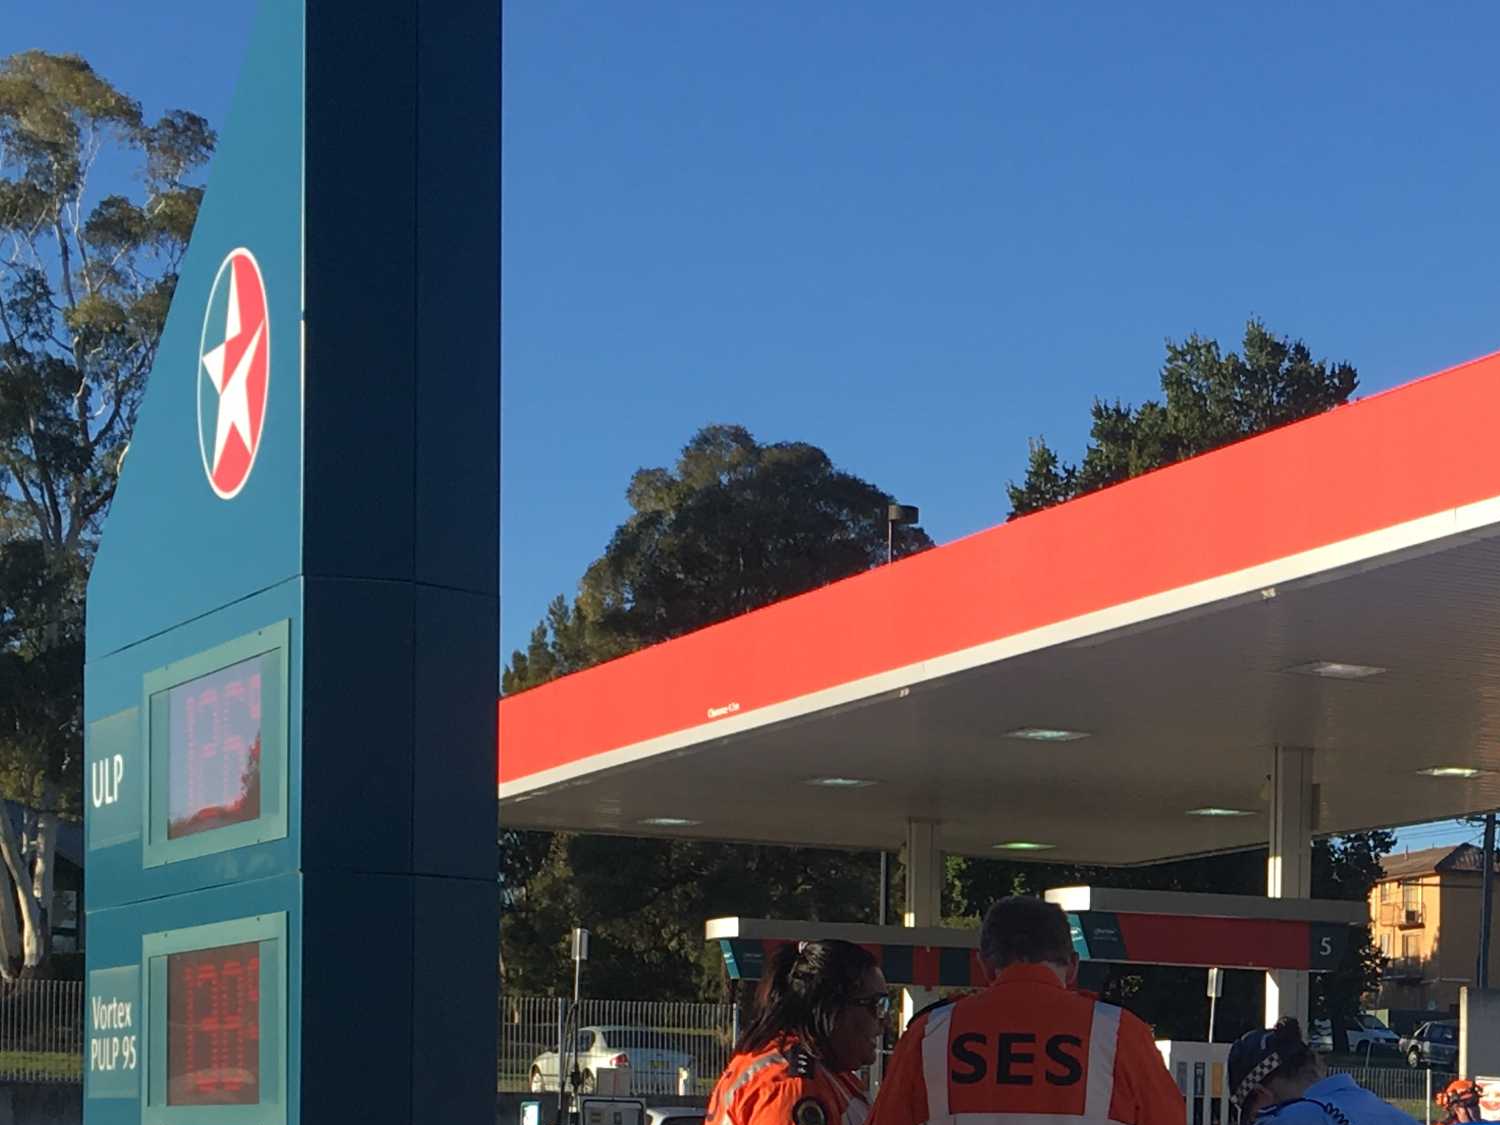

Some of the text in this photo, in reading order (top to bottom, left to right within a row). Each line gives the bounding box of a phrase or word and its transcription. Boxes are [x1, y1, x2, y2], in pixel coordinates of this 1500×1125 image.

[92, 753, 123, 808] ULP
[1320, 936, 1332, 956] 5
[92, 995, 132, 1031] Vortex
[91, 1035, 137, 1072] PULP 95
[951, 1031, 1083, 1086] SES
